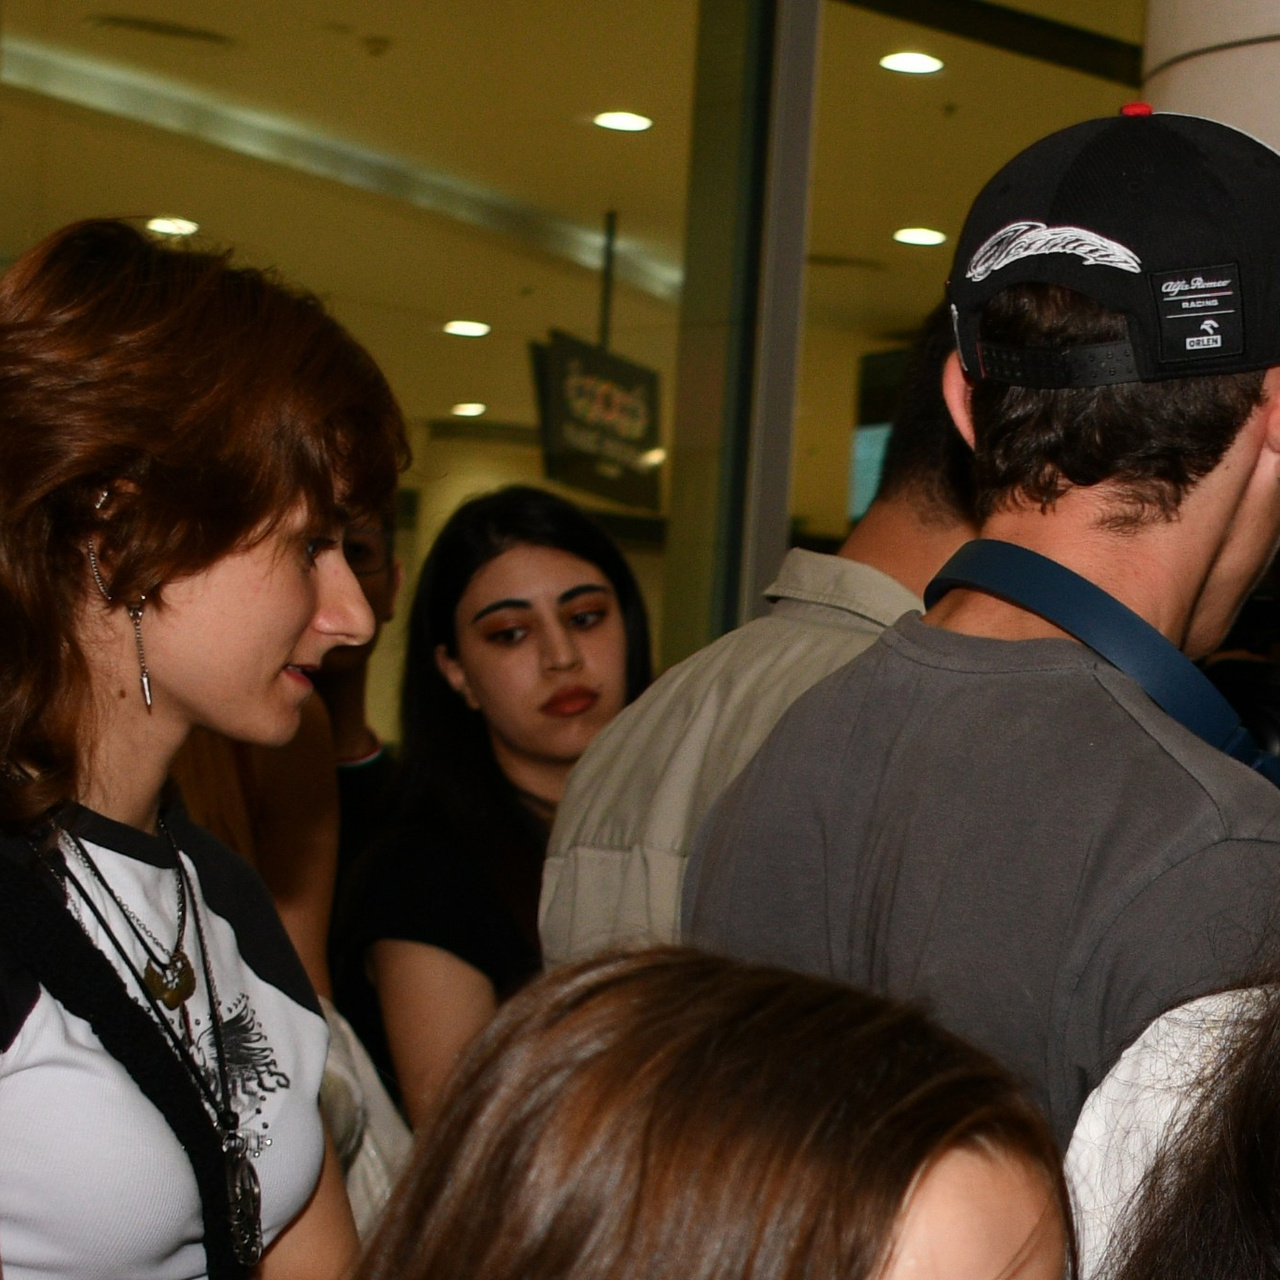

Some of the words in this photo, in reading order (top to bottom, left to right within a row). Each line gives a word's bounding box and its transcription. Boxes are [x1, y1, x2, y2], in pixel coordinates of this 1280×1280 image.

[1161, 278, 1190, 296] Alfa
[1191, 276, 1231, 289] Romeo
[1181, 298, 1219, 309] RACING
[1188, 337, 1219, 348] ORLEN
